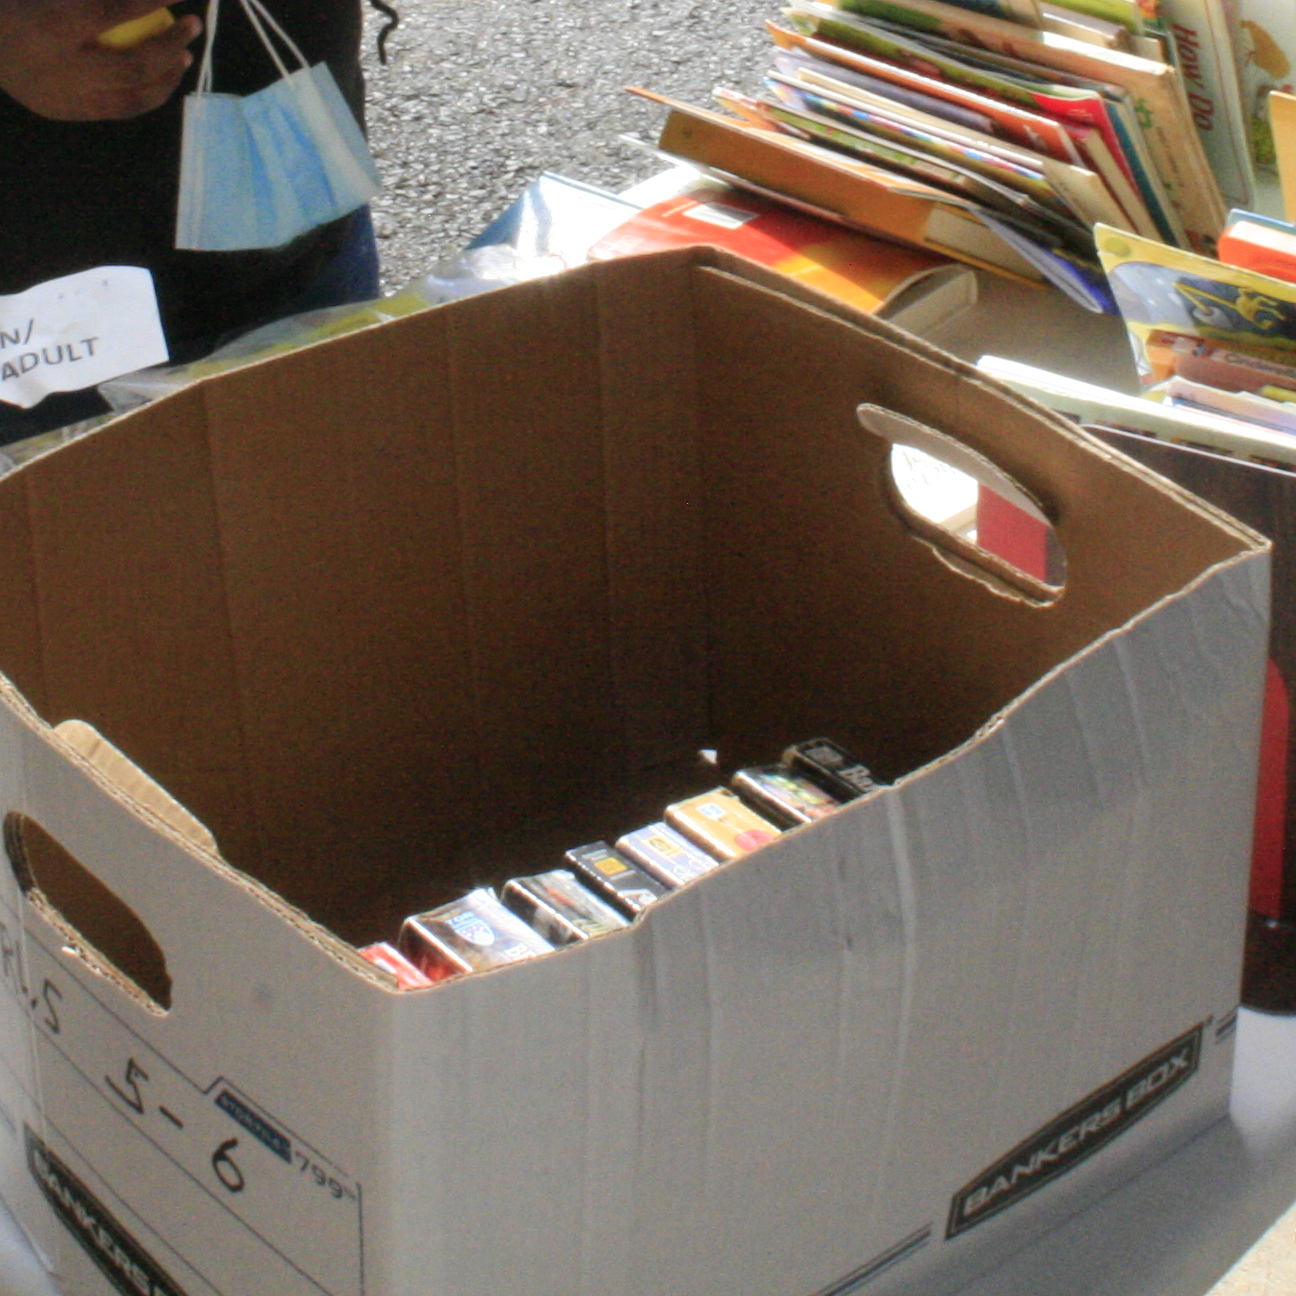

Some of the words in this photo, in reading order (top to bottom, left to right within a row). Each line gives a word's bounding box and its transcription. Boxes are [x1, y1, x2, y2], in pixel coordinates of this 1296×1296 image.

[0, 335, 100, 382] ADULT
[962, 1097, 1123, 1217] BANKERS
[1124, 1047, 1192, 1110] BOX
